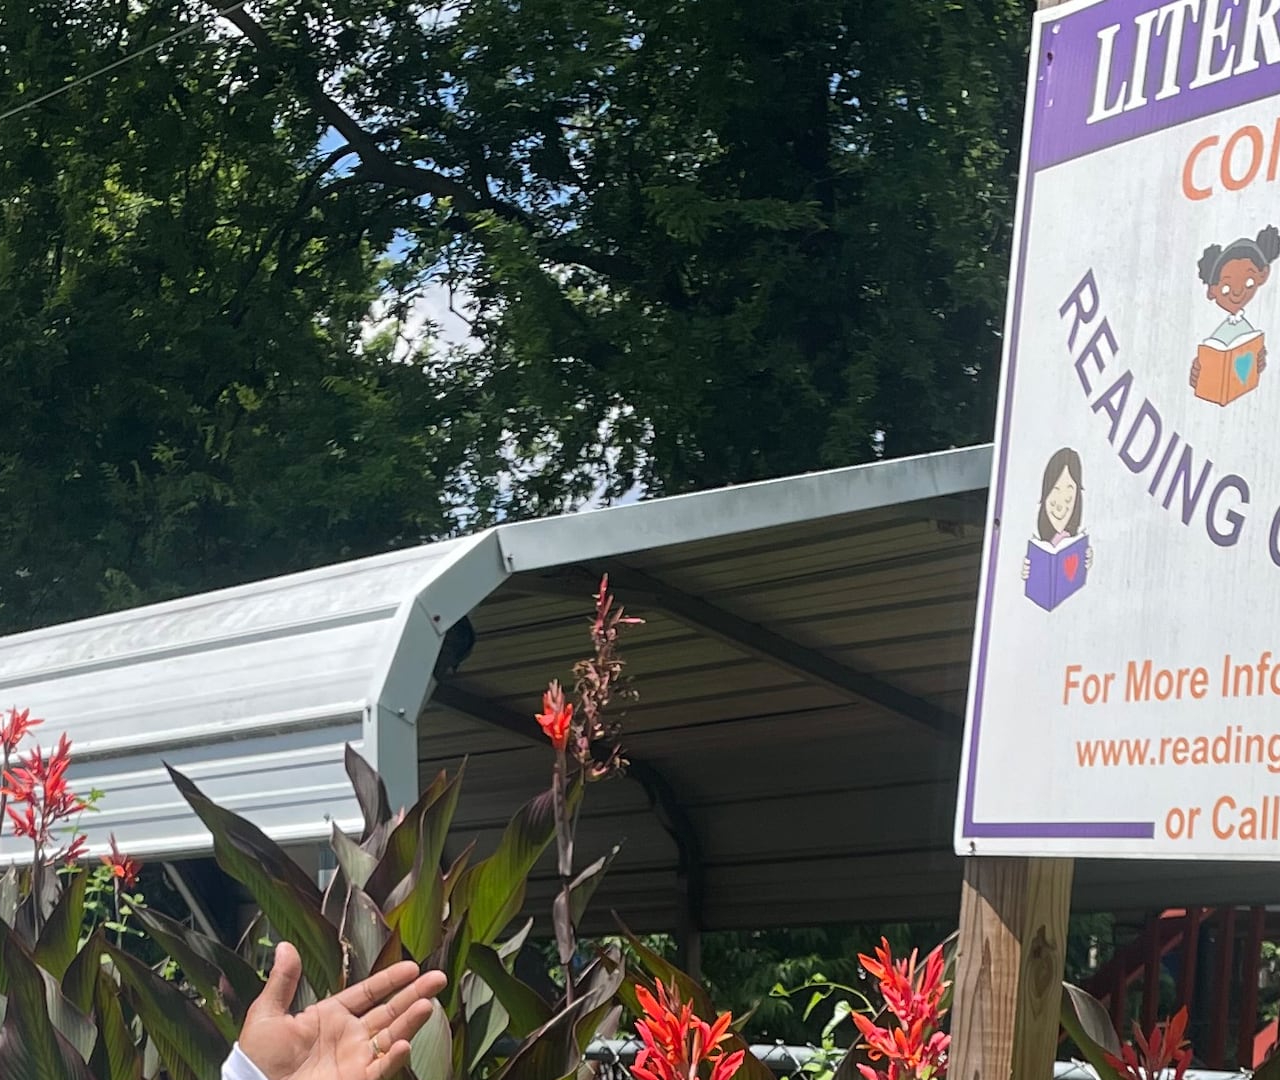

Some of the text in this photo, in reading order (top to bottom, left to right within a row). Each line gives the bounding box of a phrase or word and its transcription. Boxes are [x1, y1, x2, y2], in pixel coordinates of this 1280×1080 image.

[1058, 267, 1251, 548] READING
[1063, 664, 1116, 705] For
[1124, 659, 1210, 702] More
[1165, 806, 1202, 840] or
[1212, 795, 1280, 841] Call
